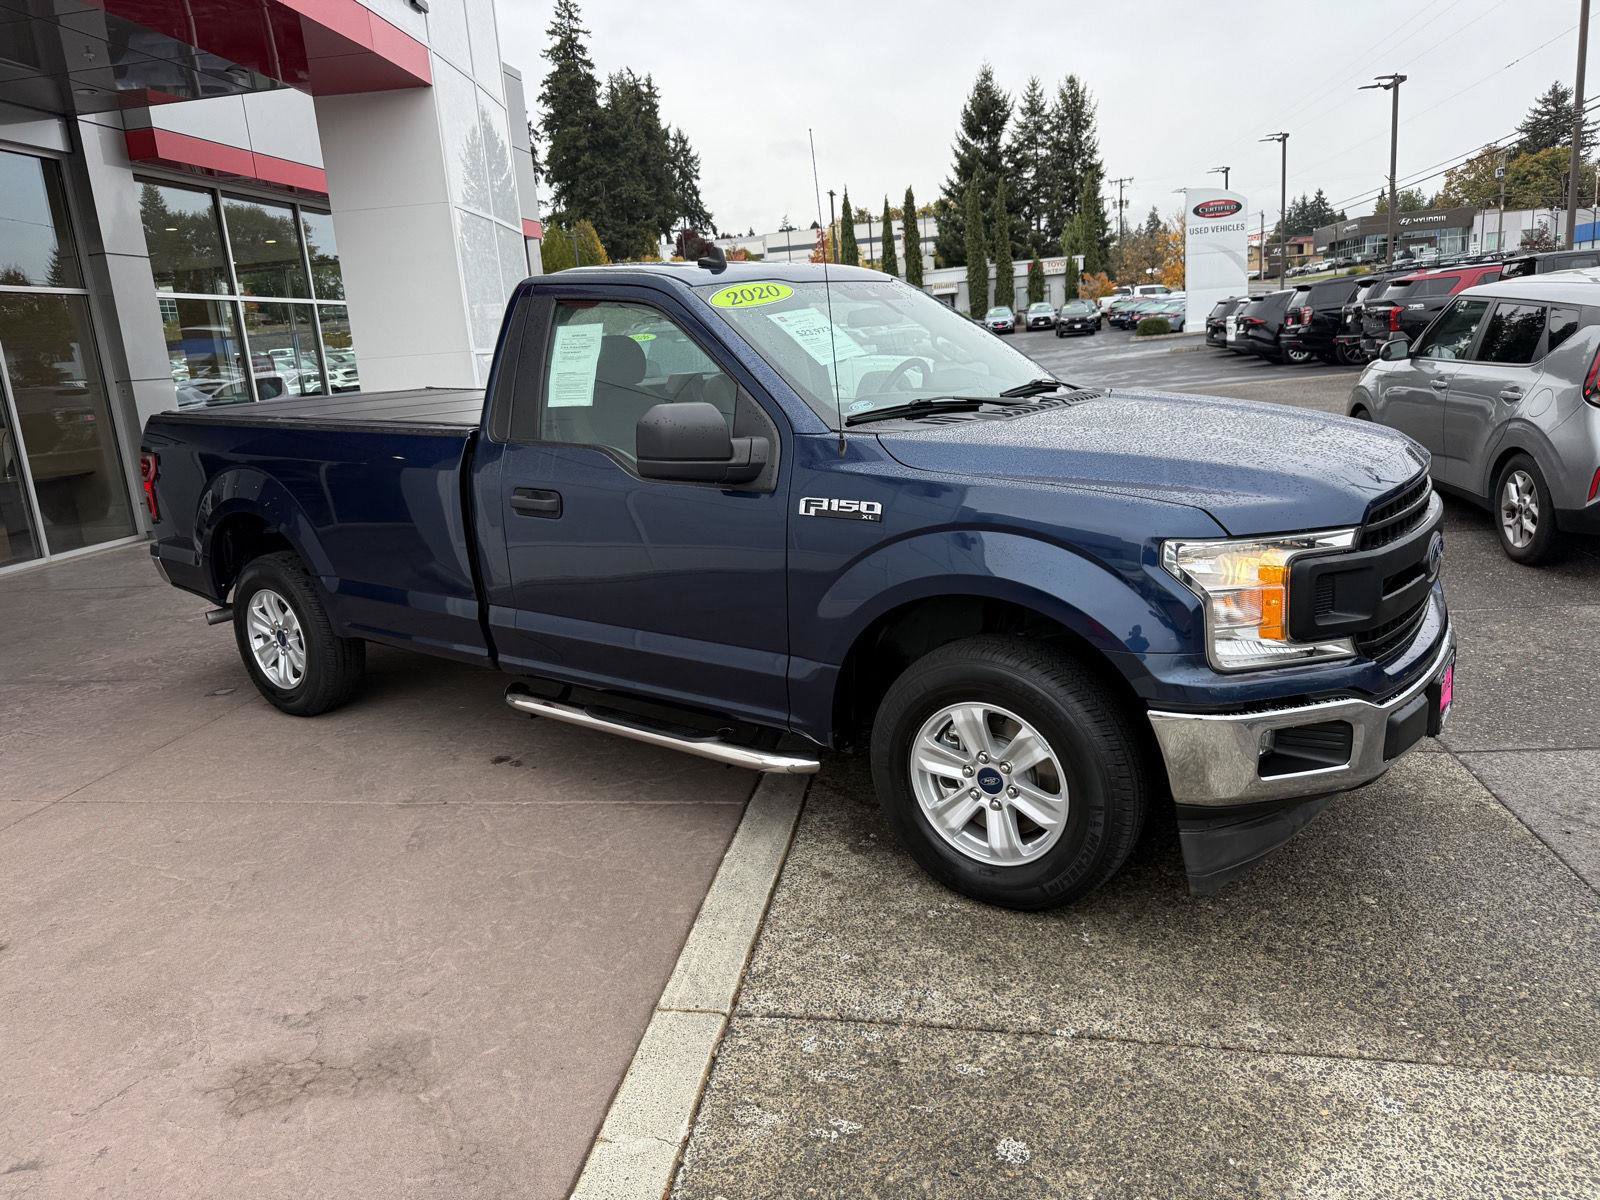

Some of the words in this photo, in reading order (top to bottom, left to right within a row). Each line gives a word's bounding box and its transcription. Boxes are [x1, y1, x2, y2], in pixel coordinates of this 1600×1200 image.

[1199, 204, 1237, 214] CERTIFIED
[1413, 215, 1447, 223] HYUNDAI
[1189, 226, 1209, 235] USED
[1210, 223, 1245, 233] VEHICLES
[1046, 260, 1066, 268] TOYO
[726, 285, 781, 306] 2020
